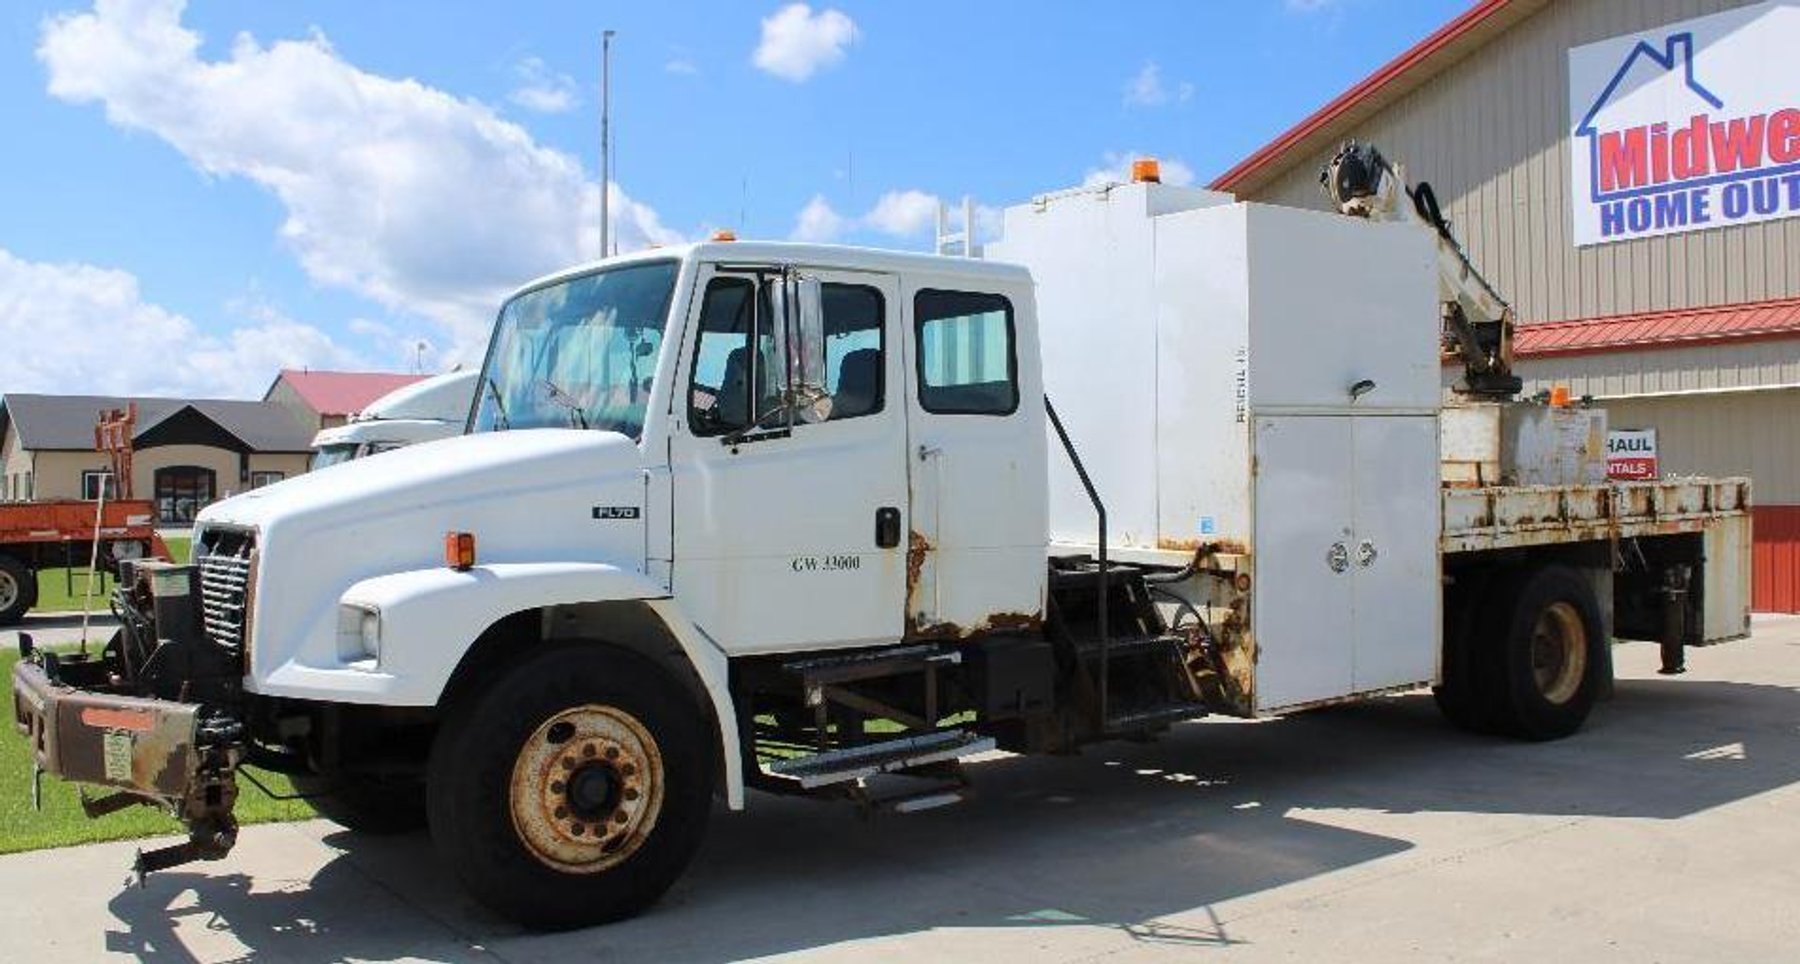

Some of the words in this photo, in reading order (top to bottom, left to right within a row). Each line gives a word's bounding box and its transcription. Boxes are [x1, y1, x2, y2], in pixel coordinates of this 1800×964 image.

[1601, 188, 1710, 236] HOME
[1722, 174, 1800, 219] OUT
[599, 508, 635, 517] FL70
